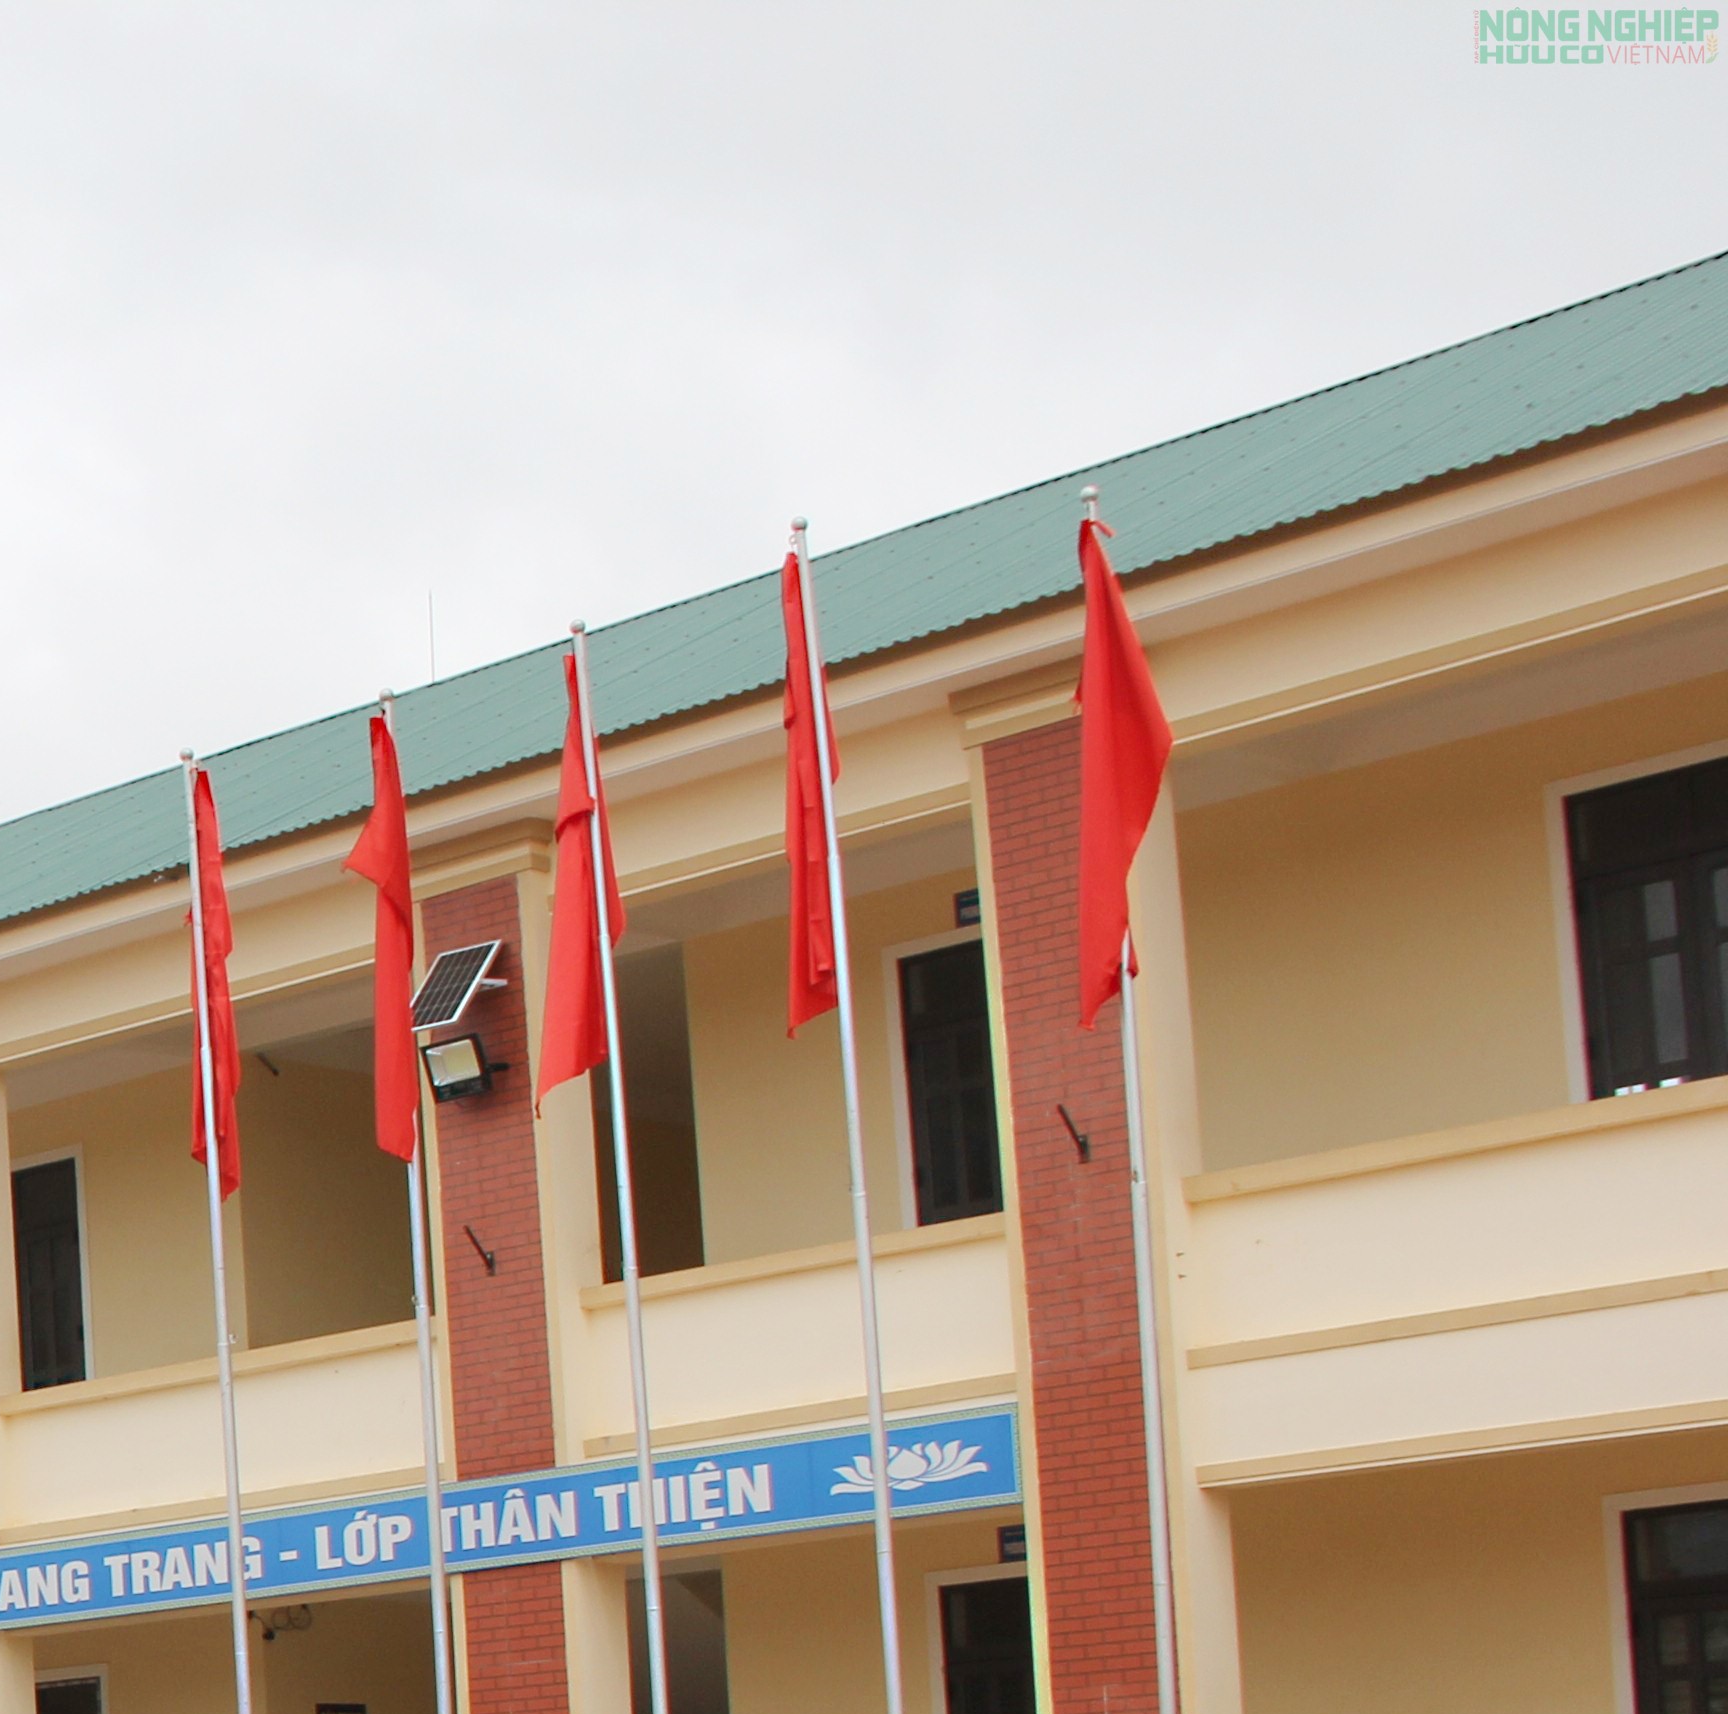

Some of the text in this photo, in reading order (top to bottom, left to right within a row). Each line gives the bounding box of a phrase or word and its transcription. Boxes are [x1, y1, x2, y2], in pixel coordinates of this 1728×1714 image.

[104, 1536, 262, 1597] TRANG
[314, 1511, 412, 1570] LỚP
[594, 1462, 772, 1531] THIỆN
